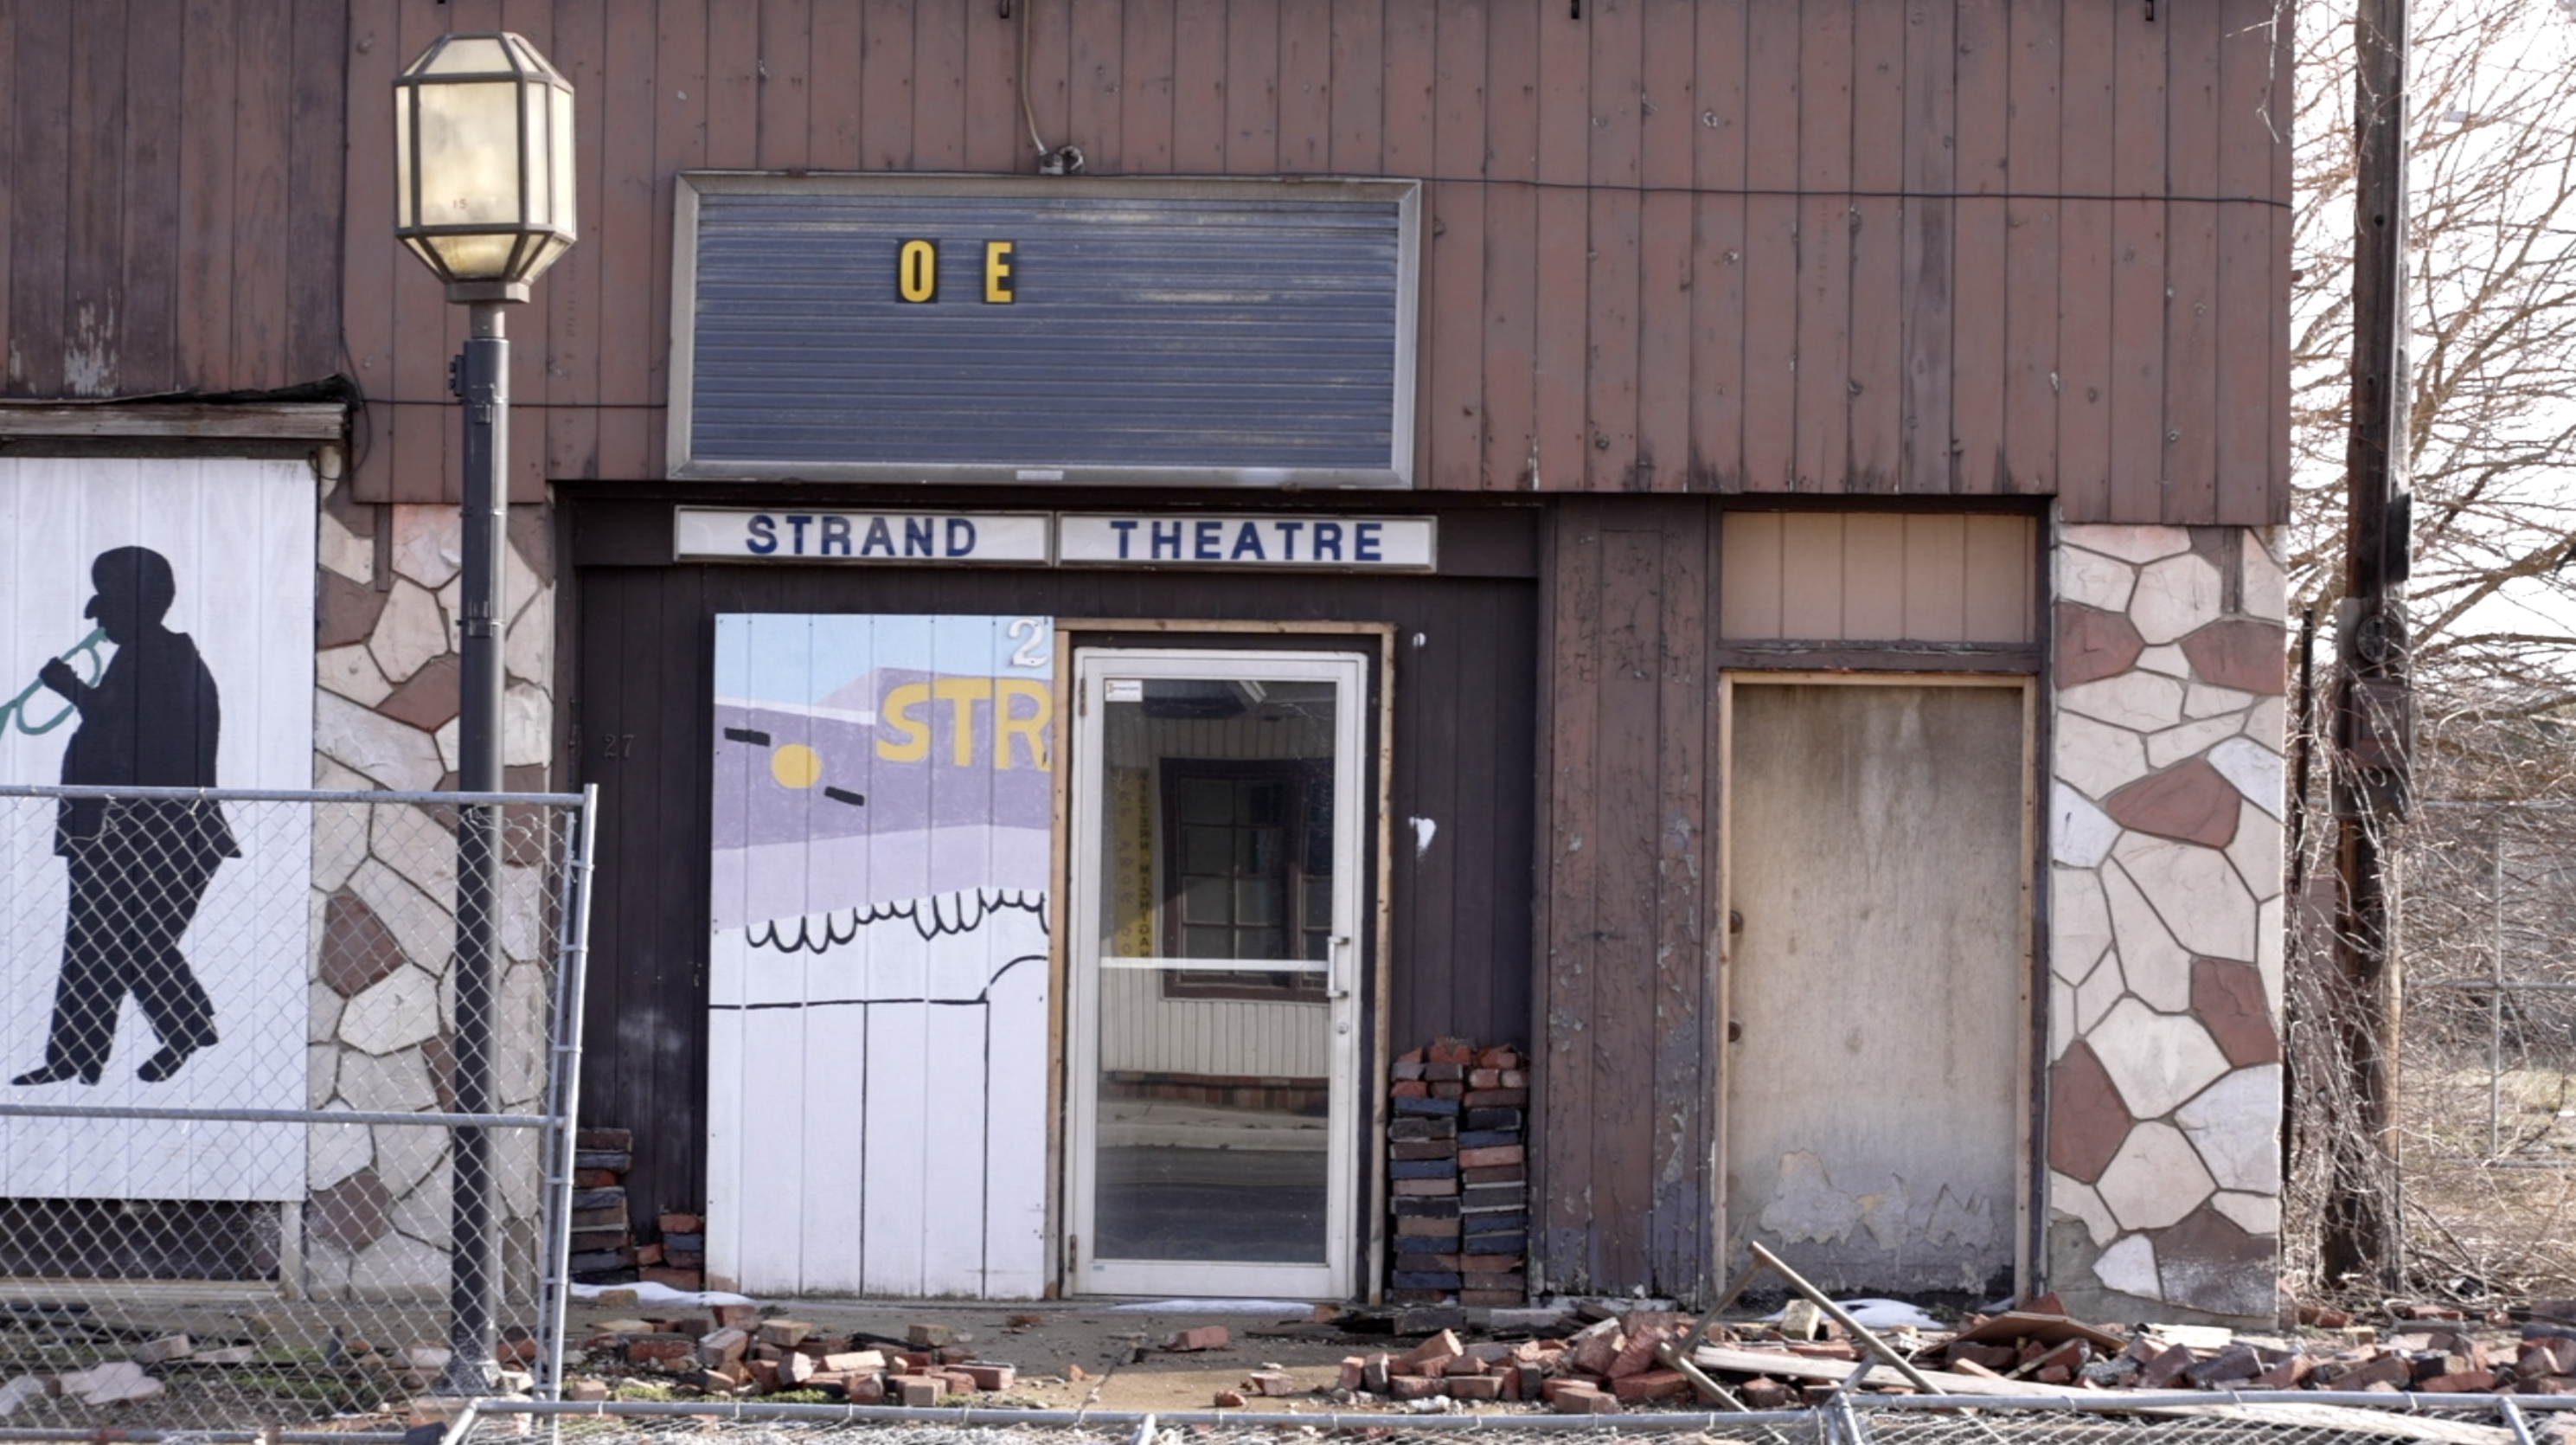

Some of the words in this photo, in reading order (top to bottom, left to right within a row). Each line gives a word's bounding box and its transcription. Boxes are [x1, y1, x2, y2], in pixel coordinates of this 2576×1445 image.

[900, 240, 934, 303] O
[986, 241, 1012, 303] E
[746, 514, 976, 556] STRAND
[1111, 520, 1382, 561] THEATRE
[1008, 618, 1048, 667] 2
[603, 733, 636, 758] 27
[876, 678, 1052, 773] STR
